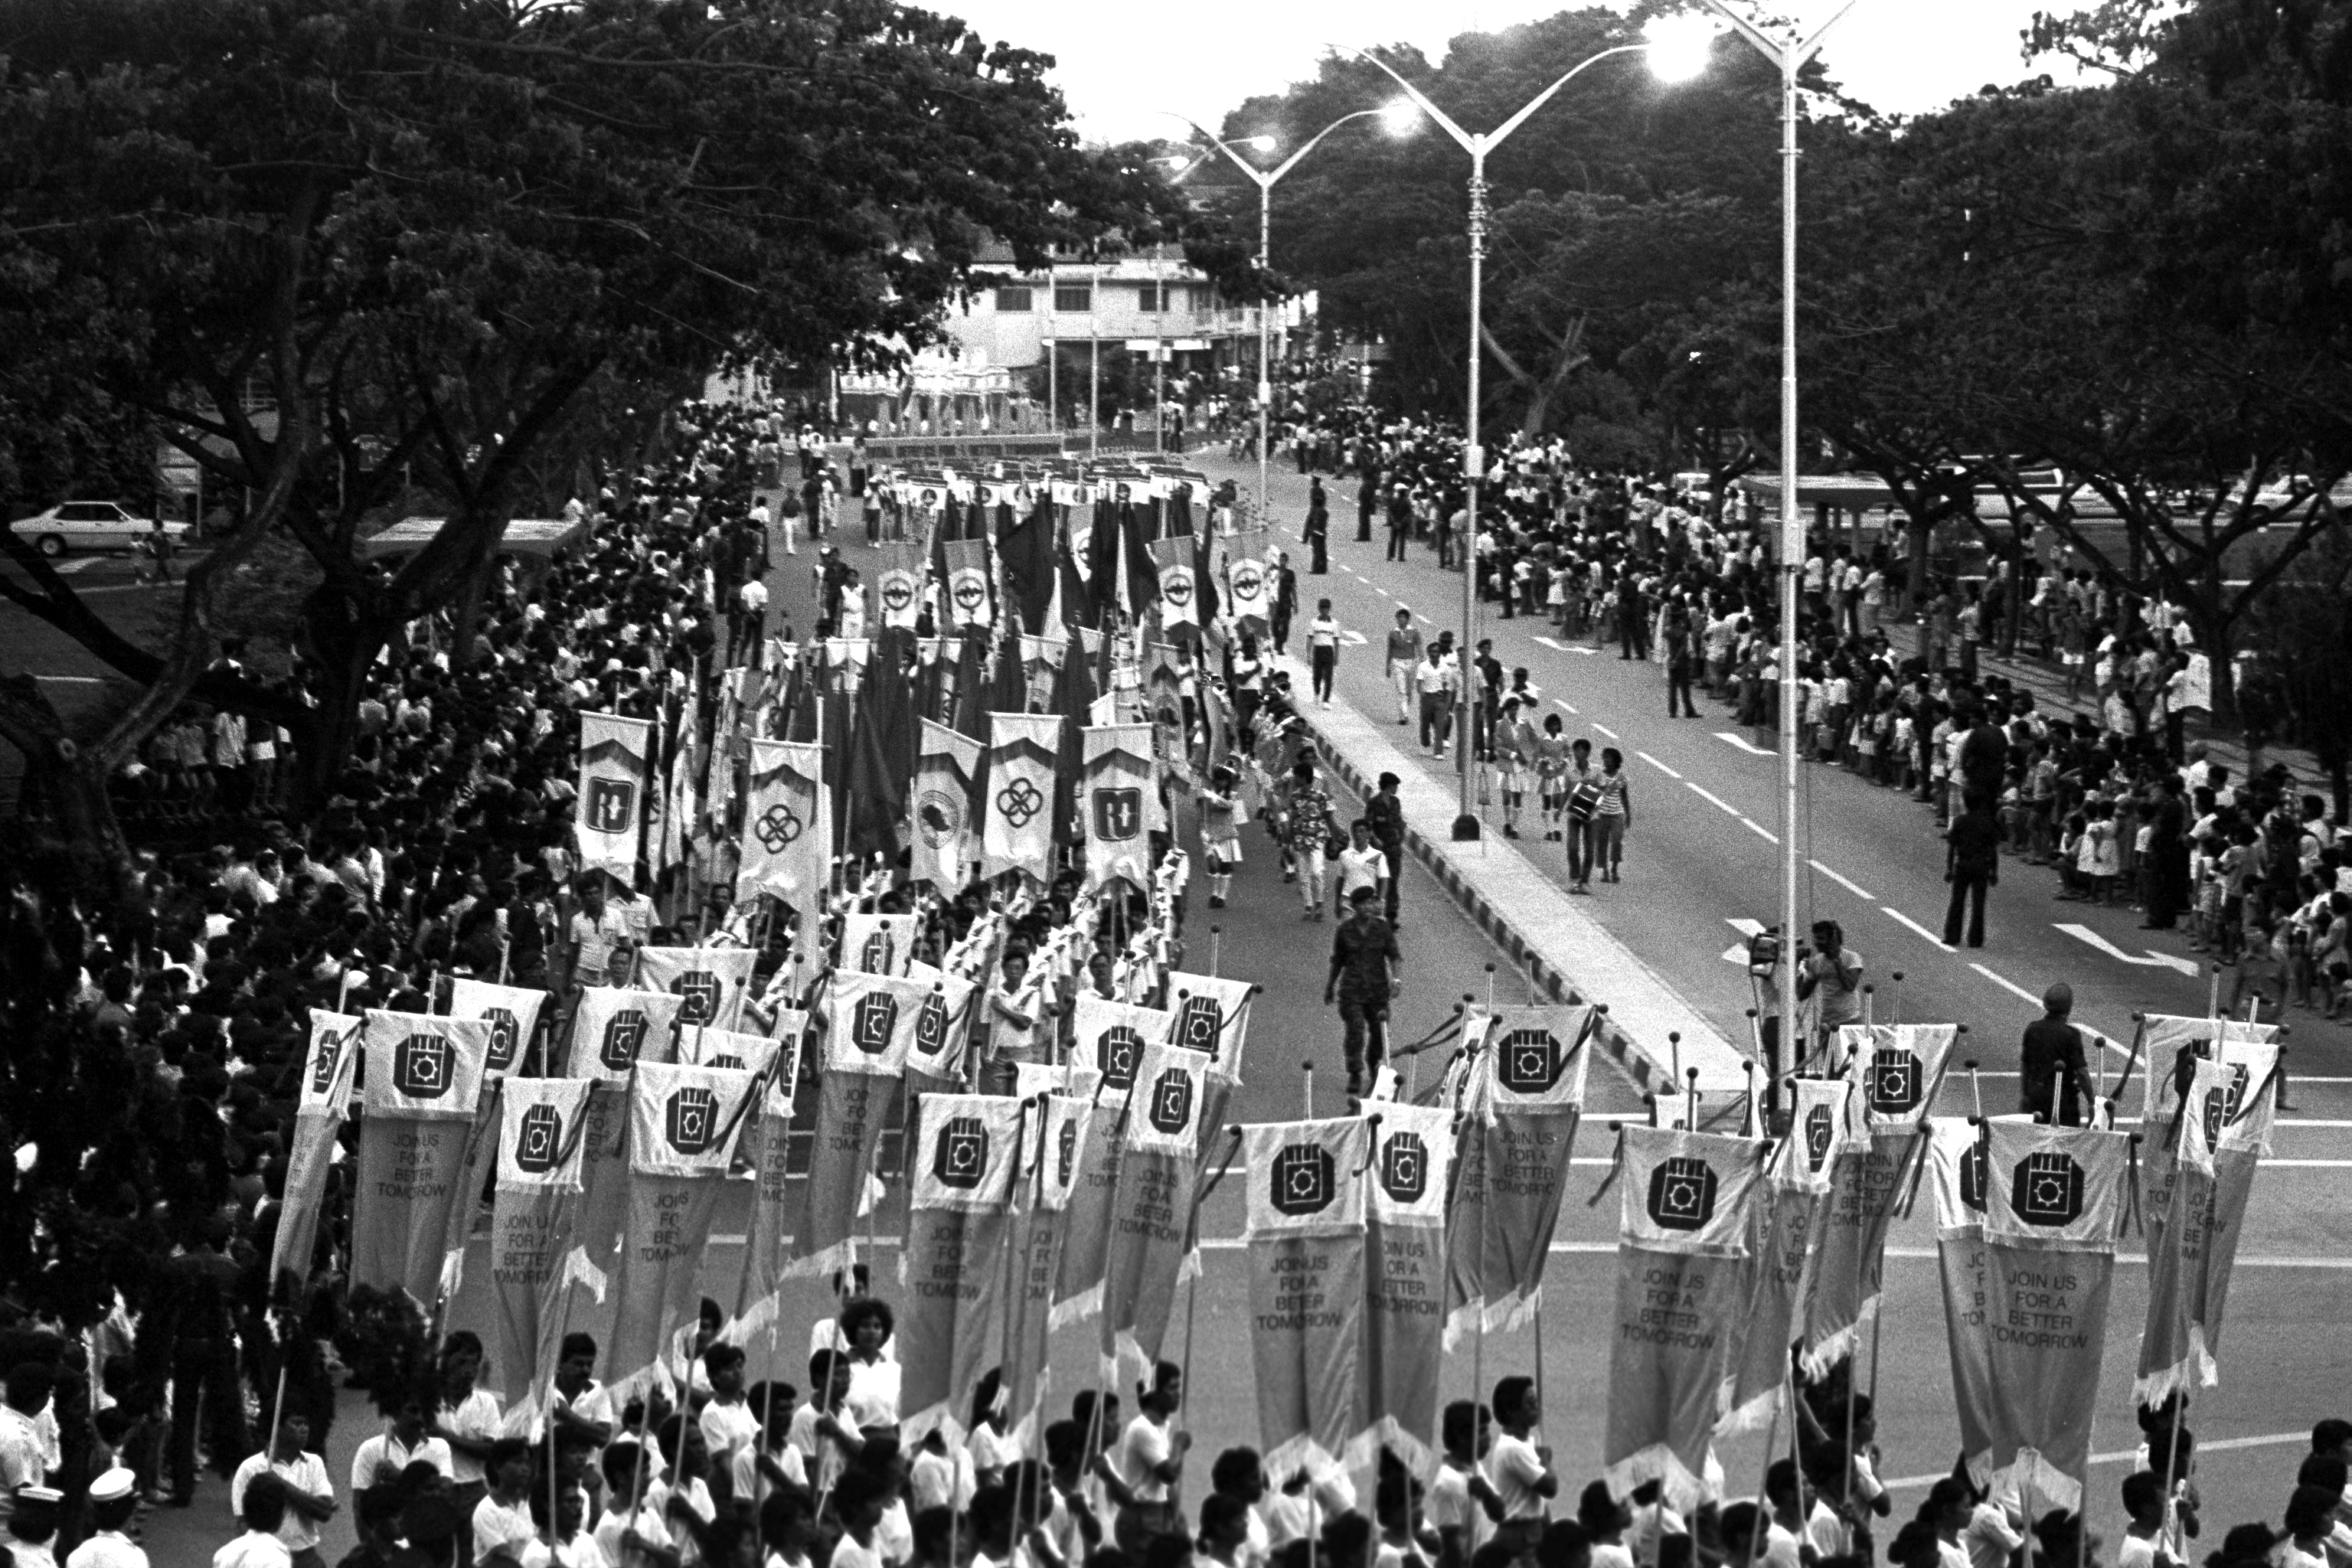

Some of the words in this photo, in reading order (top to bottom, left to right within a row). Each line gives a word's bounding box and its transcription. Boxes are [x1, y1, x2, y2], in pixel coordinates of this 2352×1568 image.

[848, 1106, 866, 1119] FO
[1501, 1132, 1532, 1145] JOIN
[1536, 1132, 1554, 1145] US
[400, 1151, 416, 1165] FO
[768, 1155, 785, 1168] FO
[1508, 1148, 1534, 1162] FOR
[1537, 1149, 1547, 1162] A
[1866, 1153, 1892, 1167] OIN
[1503, 1165, 1555, 1180] BETTER
[1139, 1186, 1160, 1202] FO
[1489, 1177, 1555, 1196] TOMORRO
[655, 1194, 678, 1209] JOI
[660, 1212, 678, 1227] FO
[1134, 1203, 1173, 1224] BETER
[505, 1215, 532, 1229] JOIN
[536, 1215, 549, 1230] U
[508, 1233, 534, 1247] FOR
[938, 1246, 960, 1260] FO
[1383, 1240, 1403, 1256] OIN
[1406, 1241, 1424, 1257] US
[1386, 1259, 1406, 1275] OR
[1409, 1261, 1421, 1276] A
[1967, 1253, 1984, 1269] JO
[1279, 1275, 1305, 1292] FO
[1306, 1273, 1318, 1289] A
[1642, 1269, 1681, 1287] JOIN
[2008, 1270, 2049, 1288] JOIN
[2053, 1274, 2078, 1292] US
[1381, 1278, 1426, 1295] ETTER
[1682, 1292, 1694, 1308] A
[2014, 1291, 2052, 1310] FOR
[2054, 1295, 2067, 1311] A
[1640, 1308, 1700, 1329] BETTER
[2007, 1309, 2074, 1331] BETTER
[1991, 1325, 2089, 1350] TOMORROW
